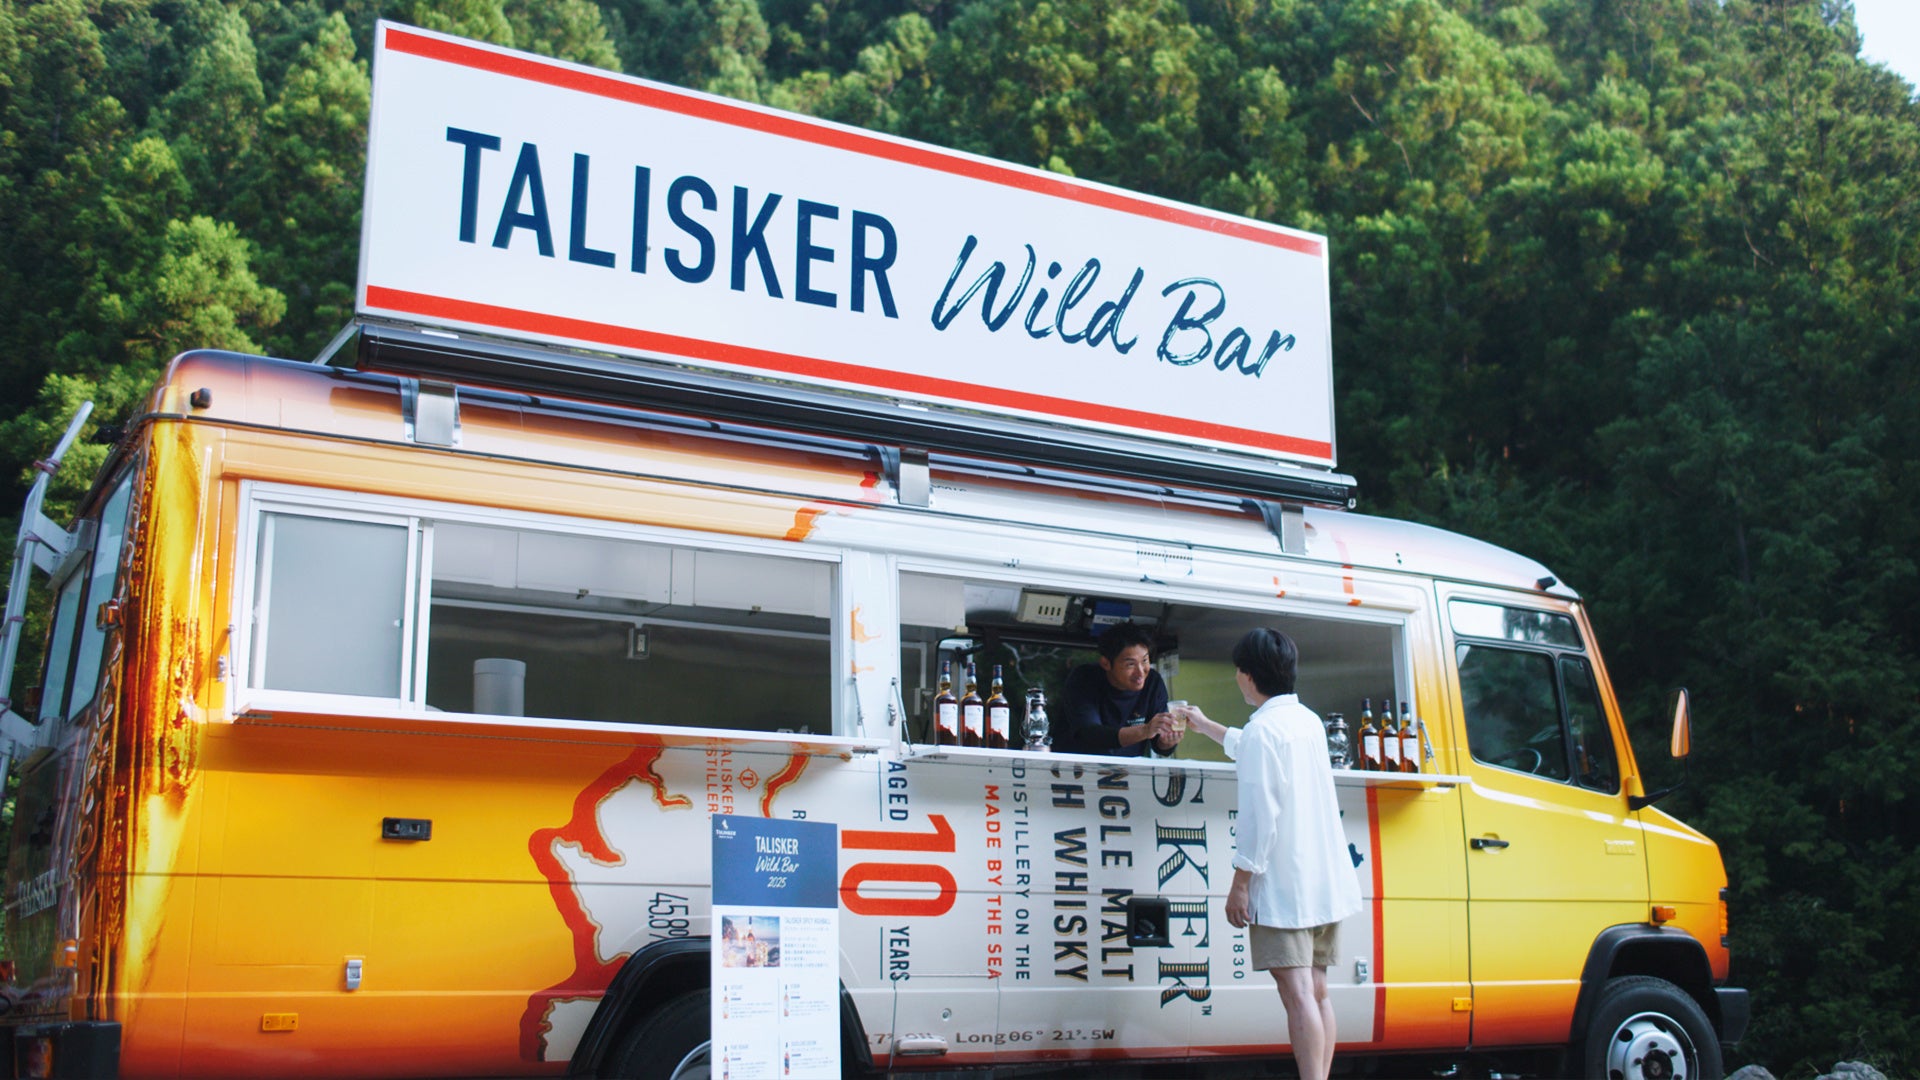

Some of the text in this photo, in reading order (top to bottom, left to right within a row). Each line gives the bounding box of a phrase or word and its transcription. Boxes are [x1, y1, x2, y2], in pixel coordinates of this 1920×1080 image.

[445, 126, 1296, 381] TALISKER Wild Bar
[888, 761, 908, 821] AGED
[755, 836, 799, 855] TALISKER
[755, 856, 799, 873] Wild Bar
[767, 876, 787, 888] 2025
[839, 814, 958, 917] 10
[984, 785, 1002, 980] MADE BY THE SEA
[1012, 766, 1030, 981] DISTILLERY ON THE
[1053, 827, 1089, 983] WHISKY
[1100, 888, 1135, 983] MALT
[889, 926, 910, 982] YEARS
[1232, 933, 1245, 980] 1830
